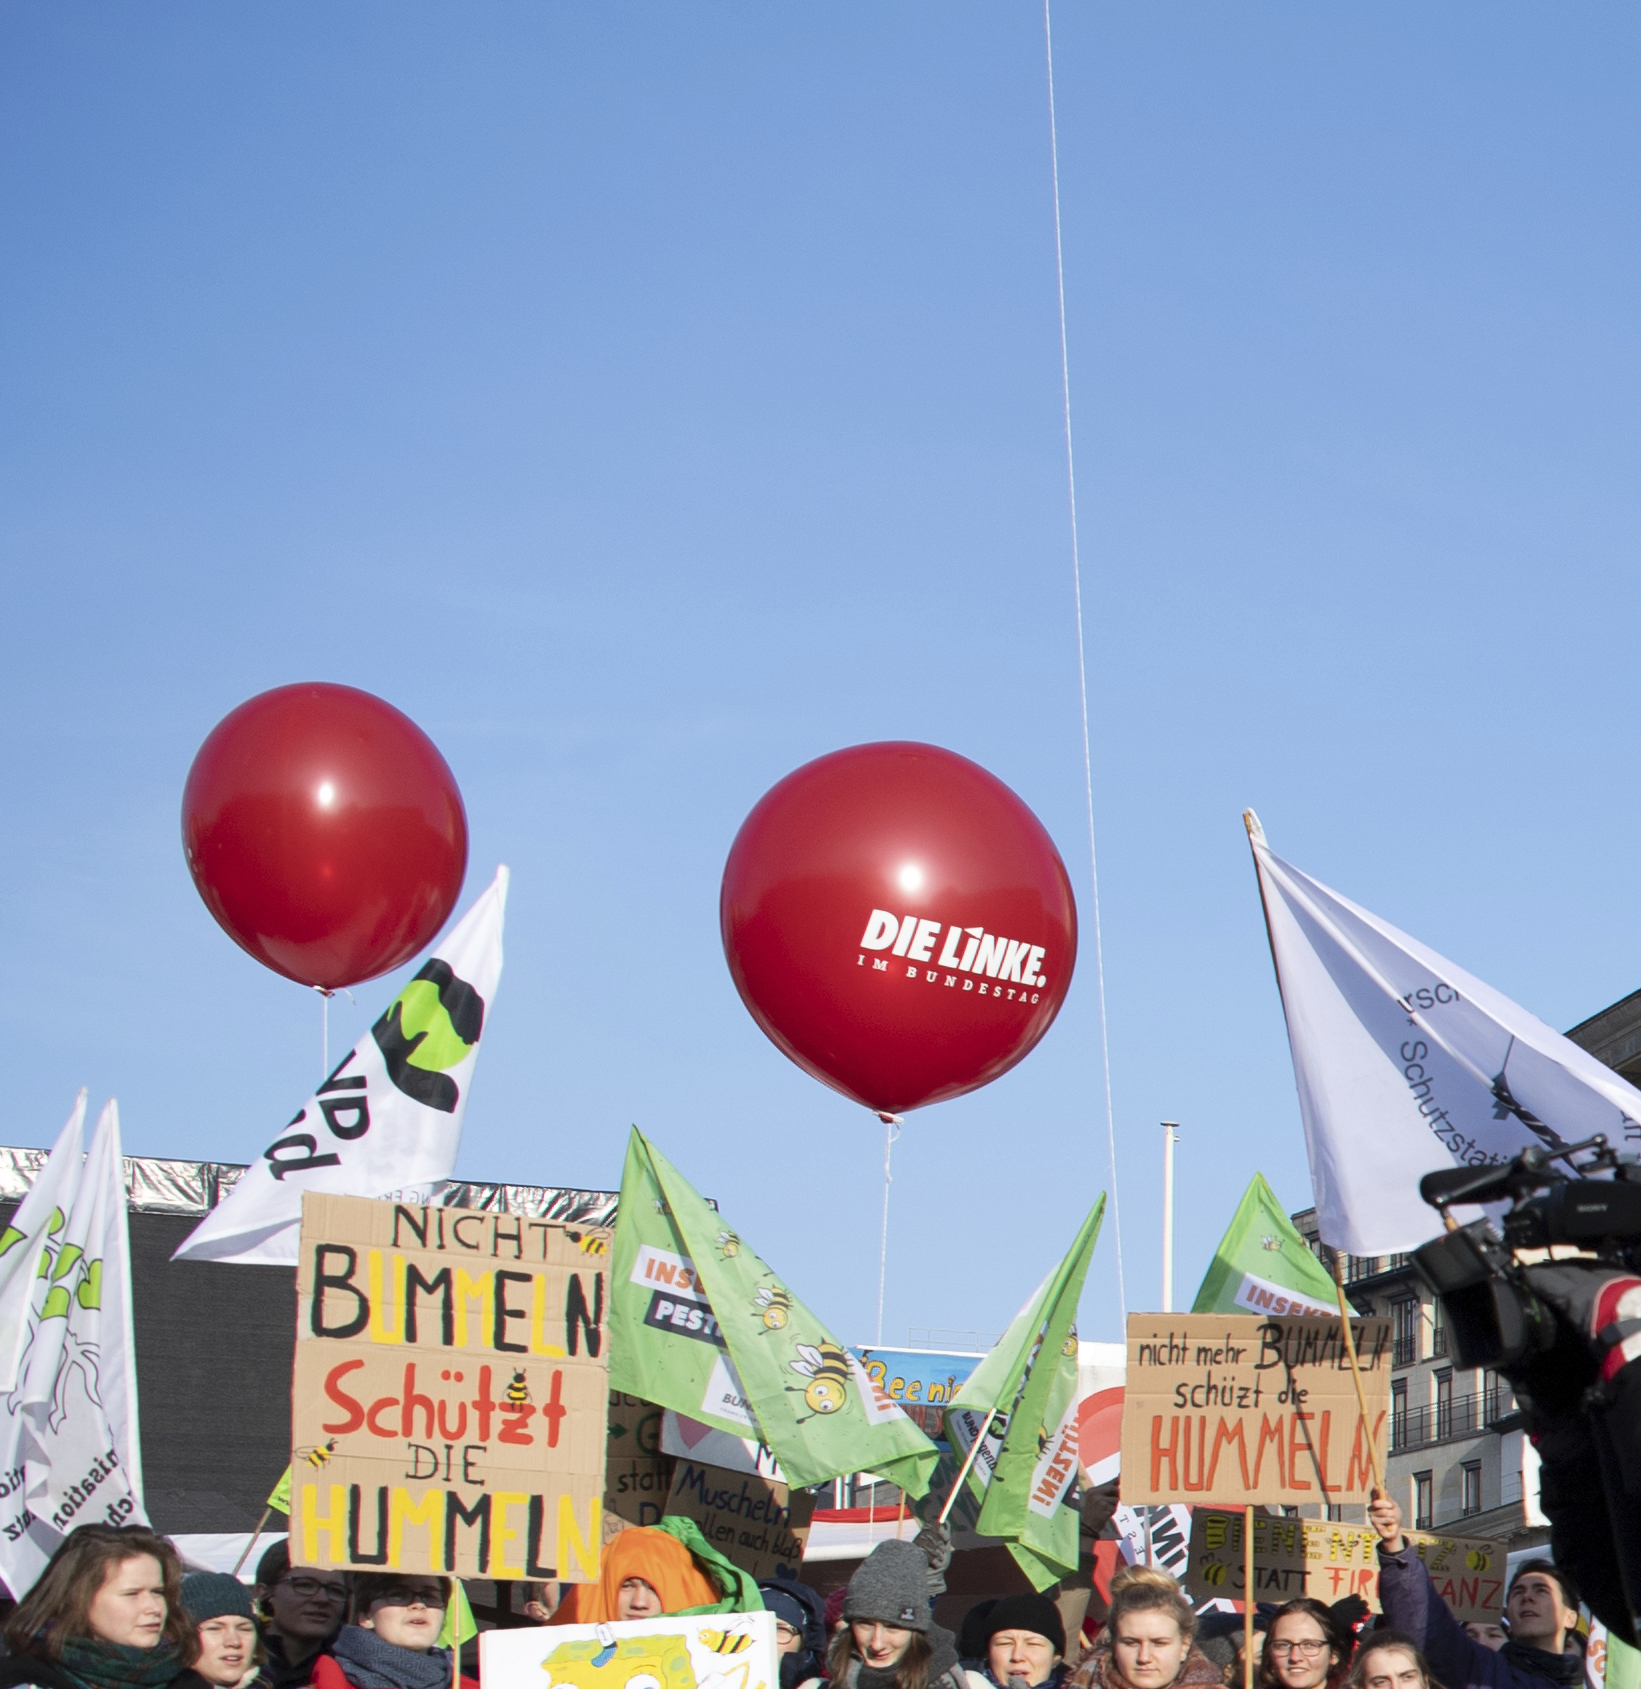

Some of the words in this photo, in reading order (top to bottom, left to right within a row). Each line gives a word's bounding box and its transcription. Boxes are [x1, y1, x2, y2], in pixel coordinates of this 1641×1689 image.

[860, 908, 942, 963] DIE
[857, 954, 888, 972] IM
[906, 966, 1039, 1005] BUNDESTAG
[391, 1204, 566, 1262] NICHT
[310, 1243, 604, 1358] BUMMELN
[1138, 1332, 1190, 1366] nicht
[1195, 1333, 1247, 1366] mehr
[1254, 1323, 1391, 1371] BUMMELN
[321, 1358, 567, 1449] Schützt
[1173, 1370, 1263, 1408] schüzt
[1277, 1376, 1309, 1405] die
[404, 1443, 488, 1487] DIE
[1150, 1410, 1387, 1493] HUMMELN
[675, 1464, 791, 1528] Muscheln
[302, 1483, 602, 1582] HUMMELN
[738, 1531, 769, 1554] auch
[1232, 1565, 1312, 1594] STATT
